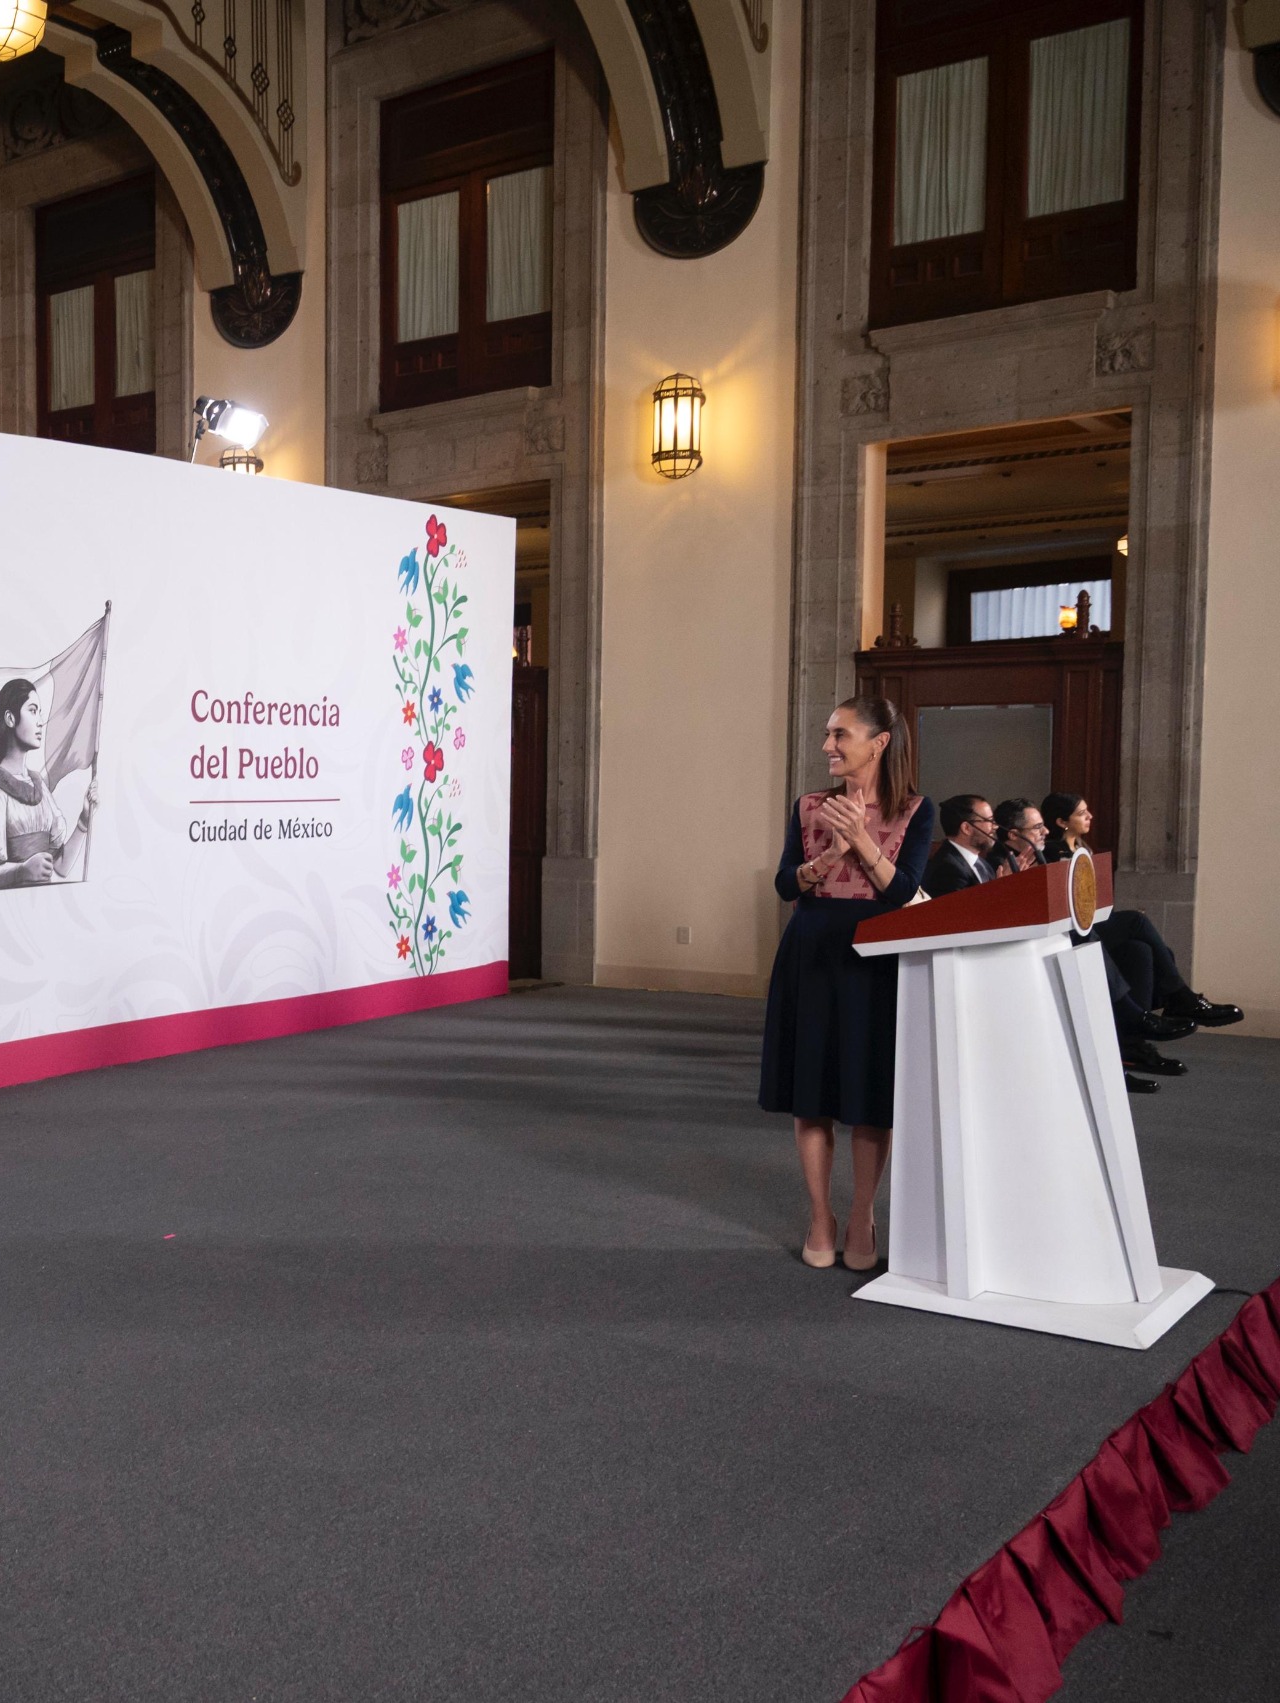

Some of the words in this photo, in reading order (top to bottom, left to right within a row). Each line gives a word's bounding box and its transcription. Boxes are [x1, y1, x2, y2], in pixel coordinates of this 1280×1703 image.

[190, 689, 341, 727] Conferencia
[189, 744, 229, 780] del
[237, 746, 319, 780] Pueblo
[189, 818, 248, 843] Ciudad
[253, 818, 273, 841] de
[277, 815, 333, 840] México
